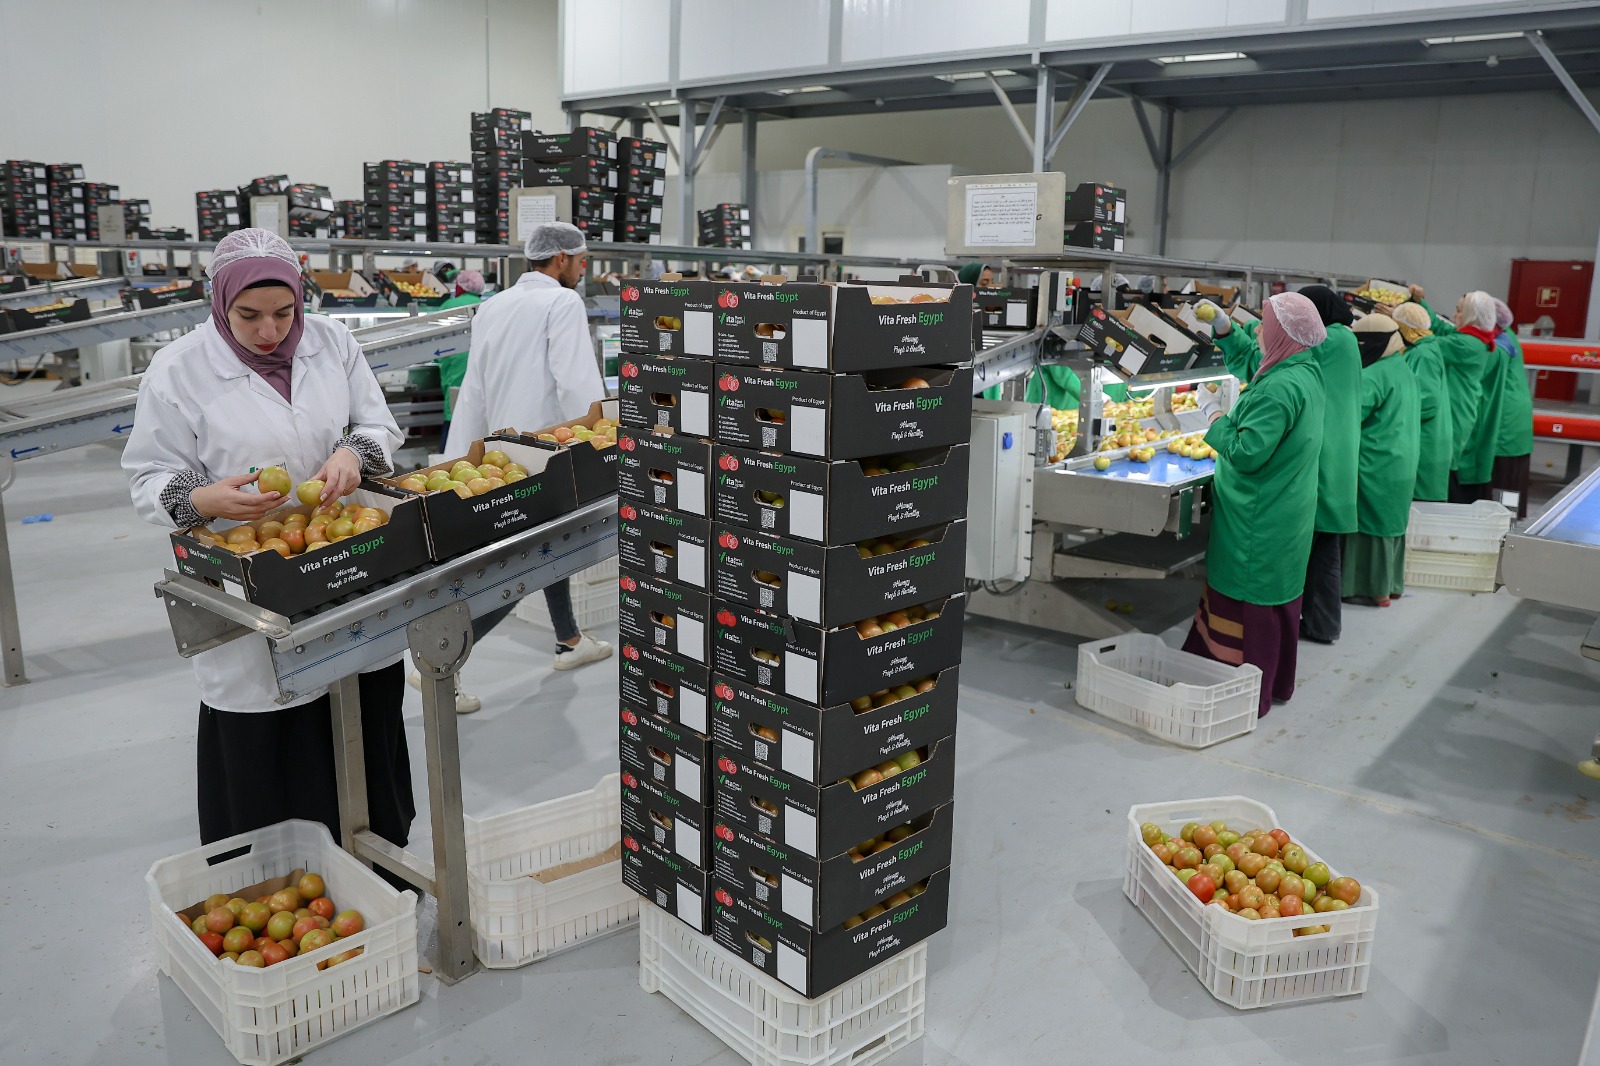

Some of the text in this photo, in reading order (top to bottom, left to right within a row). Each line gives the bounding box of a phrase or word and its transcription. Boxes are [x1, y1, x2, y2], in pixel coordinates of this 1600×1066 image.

[669, 287, 690, 296] Egypt
[775, 292, 799, 303] Egypt
[879, 312, 944, 326] Vita Fresh Egypt
[653, 365, 666, 373] Fresh
[667, 366, 687, 375] Egypt
[757, 378, 774, 386] Fresh
[774, 378, 799, 389] Egypt
[875, 396, 943, 412] Vita Fresh Egypt
[638, 438, 683, 453] Vita Fresh Egypt
[604, 454, 617, 463] Vita
[744, 458, 796, 473] Vita Fresh Egypt
[872, 476, 939, 496] Vita Fresh Egypt
[473, 483, 542, 512] Vita Fresh Egypt
[640, 509, 684, 525] Vita Fresh Egypt
[300, 536, 384, 573] Vita Fresh Egypt
[743, 537, 795, 555] Vita Fresh Egypt
[868, 552, 936, 576] Vita Fresh Egypt
[640, 581, 684, 600] Vita Fresh Egypt
[741, 615, 752, 624] Vita
[753, 619, 768, 629] Fresh
[867, 628, 933, 656] Vita Fresh Egypt
[642, 650, 685, 672] Vita Fresh Egypt
[739, 690, 789, 715] Vita Fresh Egypt
[640, 716, 681, 741] Vita Fresh Egypt
[782, 721, 797, 730] Product
[864, 704, 929, 734] Vita Fresh Egypt
[742, 765, 791, 790] Vita Fresh Egypt
[862, 769, 927, 804] Vita Fresh Egypt
[641, 780, 681, 806] Vita Fresh Egypt
[785, 797, 799, 806] Product
[738, 832, 787, 859] Vita Fresh Egypt
[642, 844, 683, 872] Vita Fresh Egypt
[860, 842, 924, 879] Vita Fresh Egypt
[783, 866, 796, 875] Product
[737, 898, 784, 928] Vita Fresh Egypt
[853, 904, 919, 943] Vita Fresh Egypt
